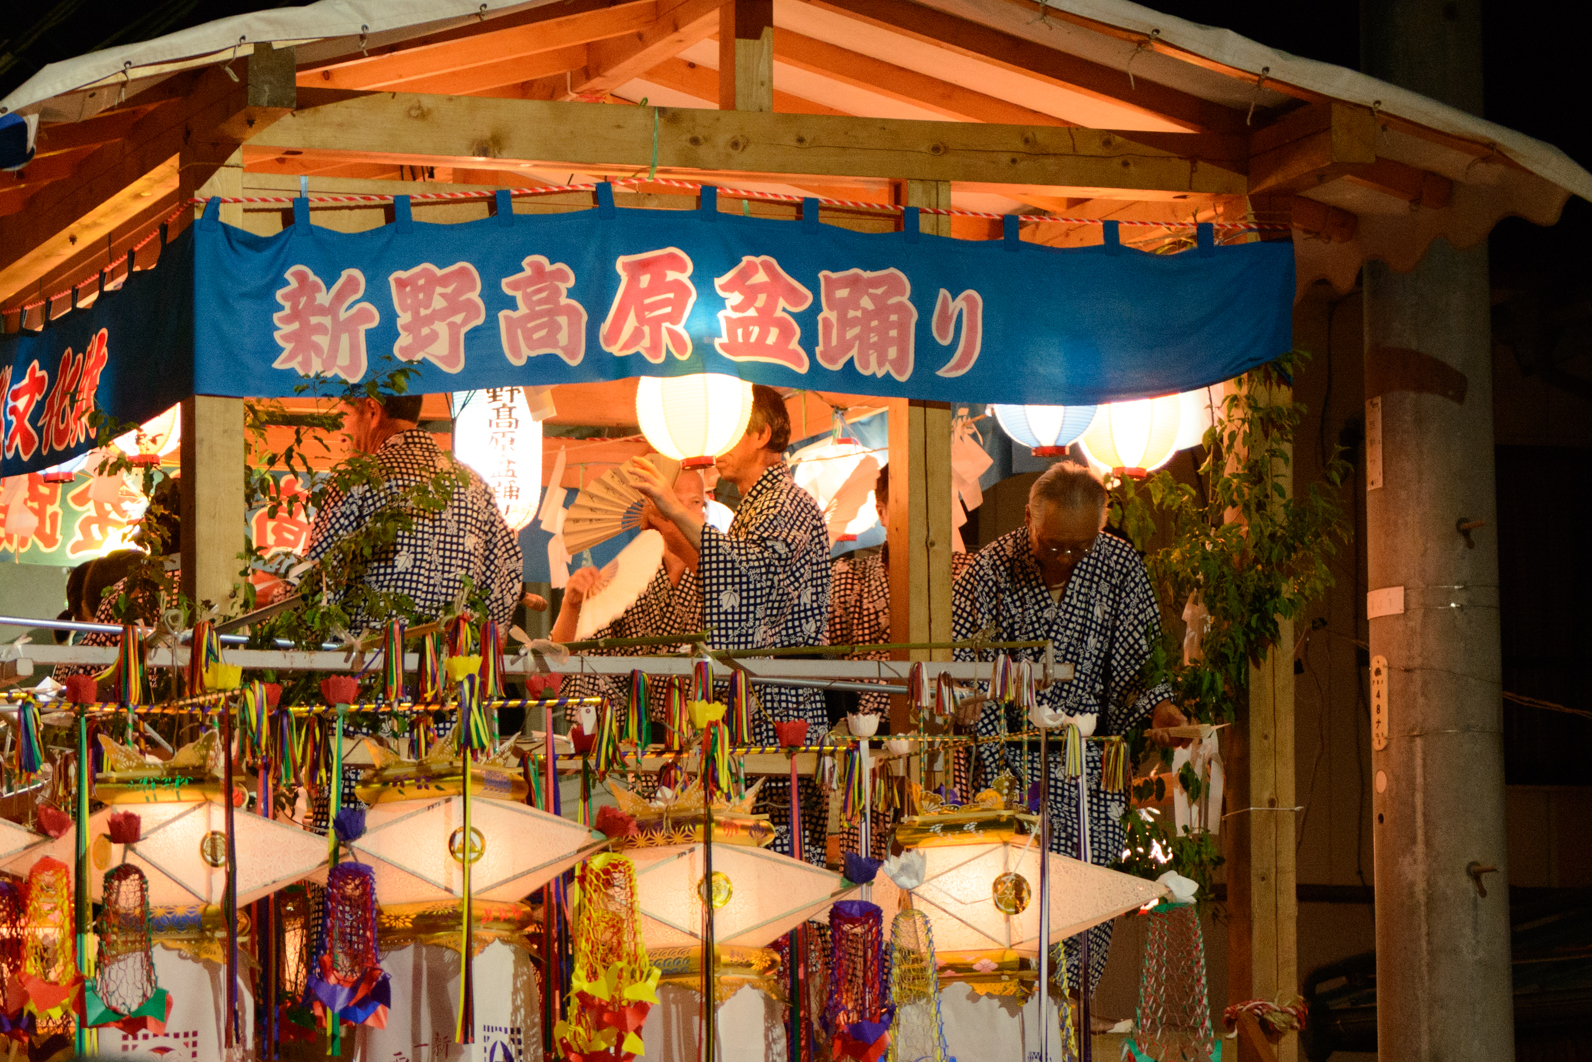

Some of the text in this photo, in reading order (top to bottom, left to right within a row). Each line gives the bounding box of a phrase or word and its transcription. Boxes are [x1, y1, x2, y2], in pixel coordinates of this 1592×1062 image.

[272, 247, 983, 382] 新野高原盆踊り
